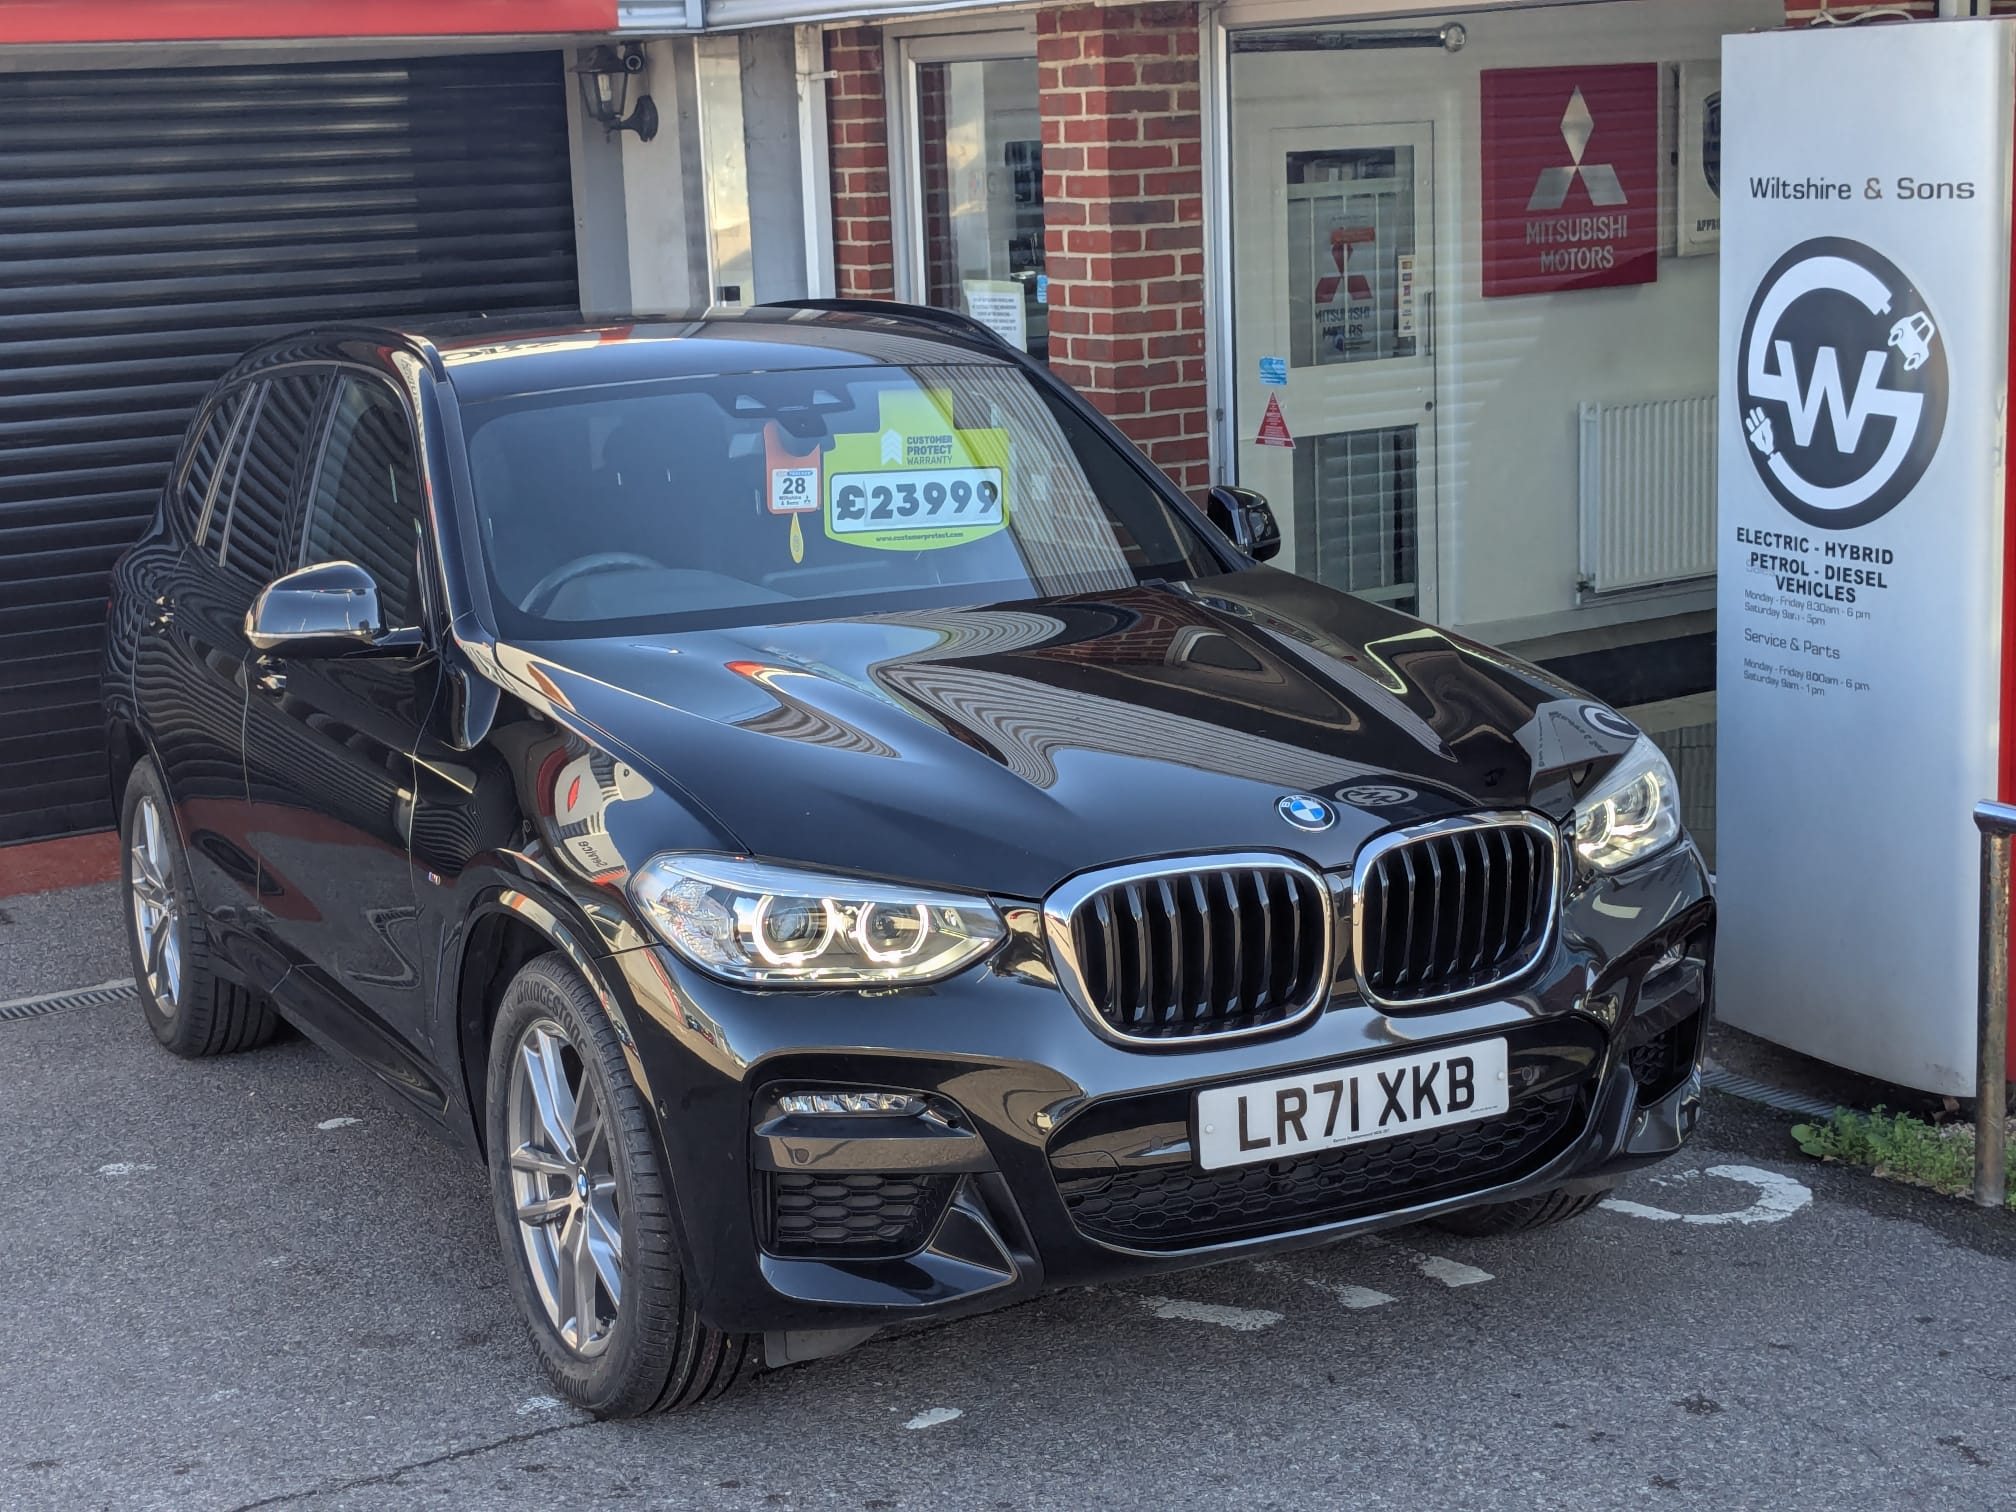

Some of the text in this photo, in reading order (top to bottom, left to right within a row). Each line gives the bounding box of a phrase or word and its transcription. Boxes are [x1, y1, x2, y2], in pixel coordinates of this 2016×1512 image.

[1750, 177, 1975, 200] Wiltshire & Sons
[1526, 215, 1628, 245] MITSUBISHI
[1540, 245, 1614, 273] MOTORS
[906, 435, 953, 445] CUSTOMER
[906, 444, 953, 456] PROTECT
[906, 455, 953, 465] WARRANTY
[782, 477, 806, 495] 28
[836, 480, 999, 520] £23999
[1736, 527, 1809, 553] ELECTRIC
[1824, 541, 1894, 565] HYBRID
[1750, 551, 1810, 577] PETROL
[1824, 564, 1888, 589] DIESEL
[1775, 574, 1856, 603] VEHICLES
[1744, 589, 1774, 605] Monday
[1780, 595, 1805, 611] Friday
[1846, 607, 1854, 617] 6
[1855, 610, 1871, 620] pm
[1744, 601, 1780, 618] Saturday
[1744, 627, 1841, 660] Service & Parts
[1743, 657, 1773, 674] Monday
[1779, 664, 1804, 680] Friday
[1845, 678, 1853, 689] 6
[1854, 681, 1870, 692] pm
[1743, 670, 1780, 688] Saturday
[1780, 678, 1800, 691] 9am
[1237, 1056, 1475, 1152] LR71 XKB
